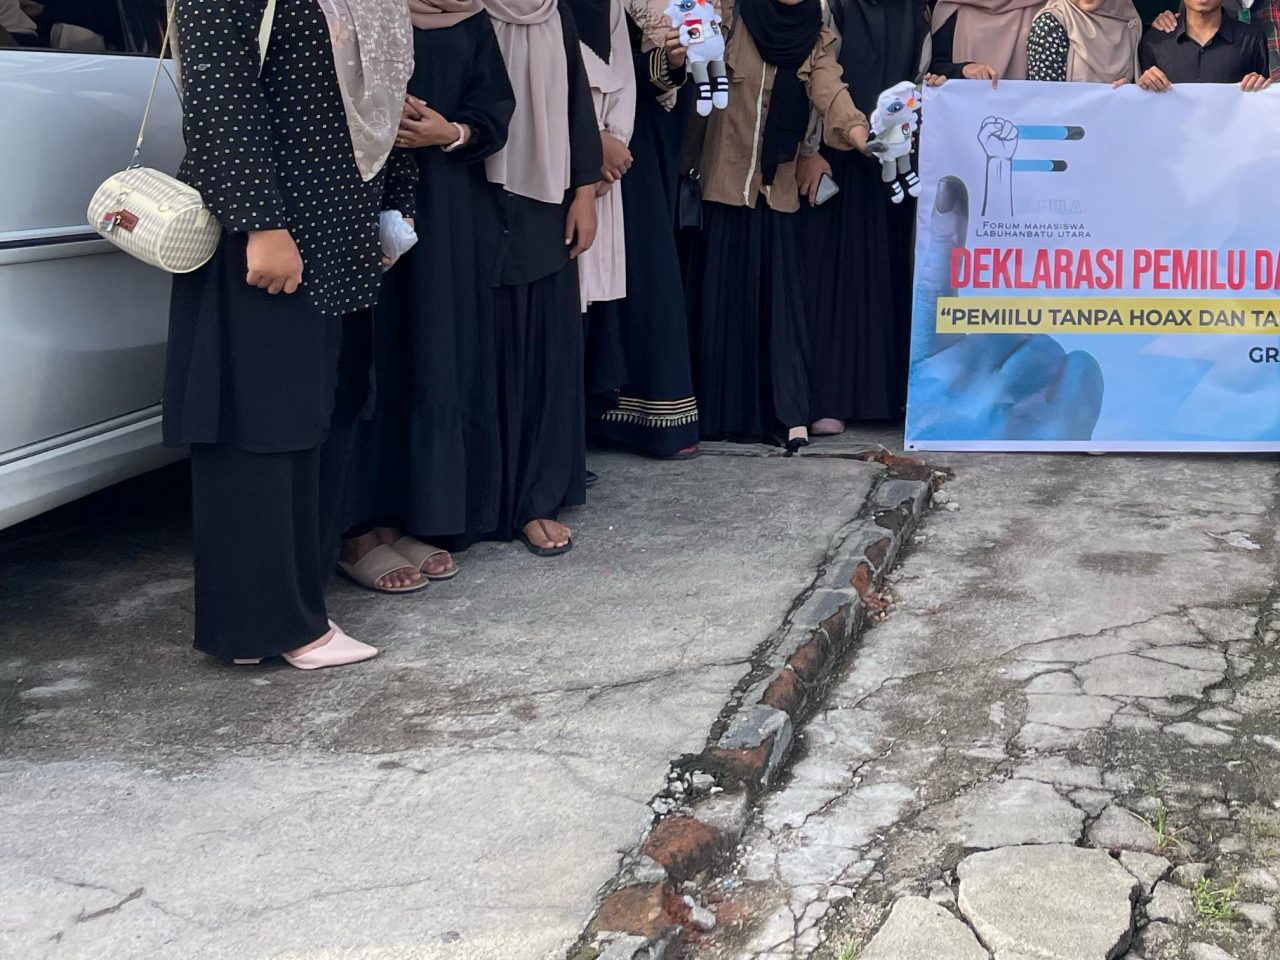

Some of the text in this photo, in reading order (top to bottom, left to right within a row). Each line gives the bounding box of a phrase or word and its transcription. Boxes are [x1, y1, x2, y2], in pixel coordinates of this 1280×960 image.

[976, 229, 1054, 238] LABUHANBATU
[950, 248, 1123, 289] DEKLARASI
[1132, 249, 1246, 290] PEMILU
[1048, 309, 1122, 326] TANPA
[1129, 309, 1192, 326] HOAX
[1199, 310, 1245, 327] DAN
